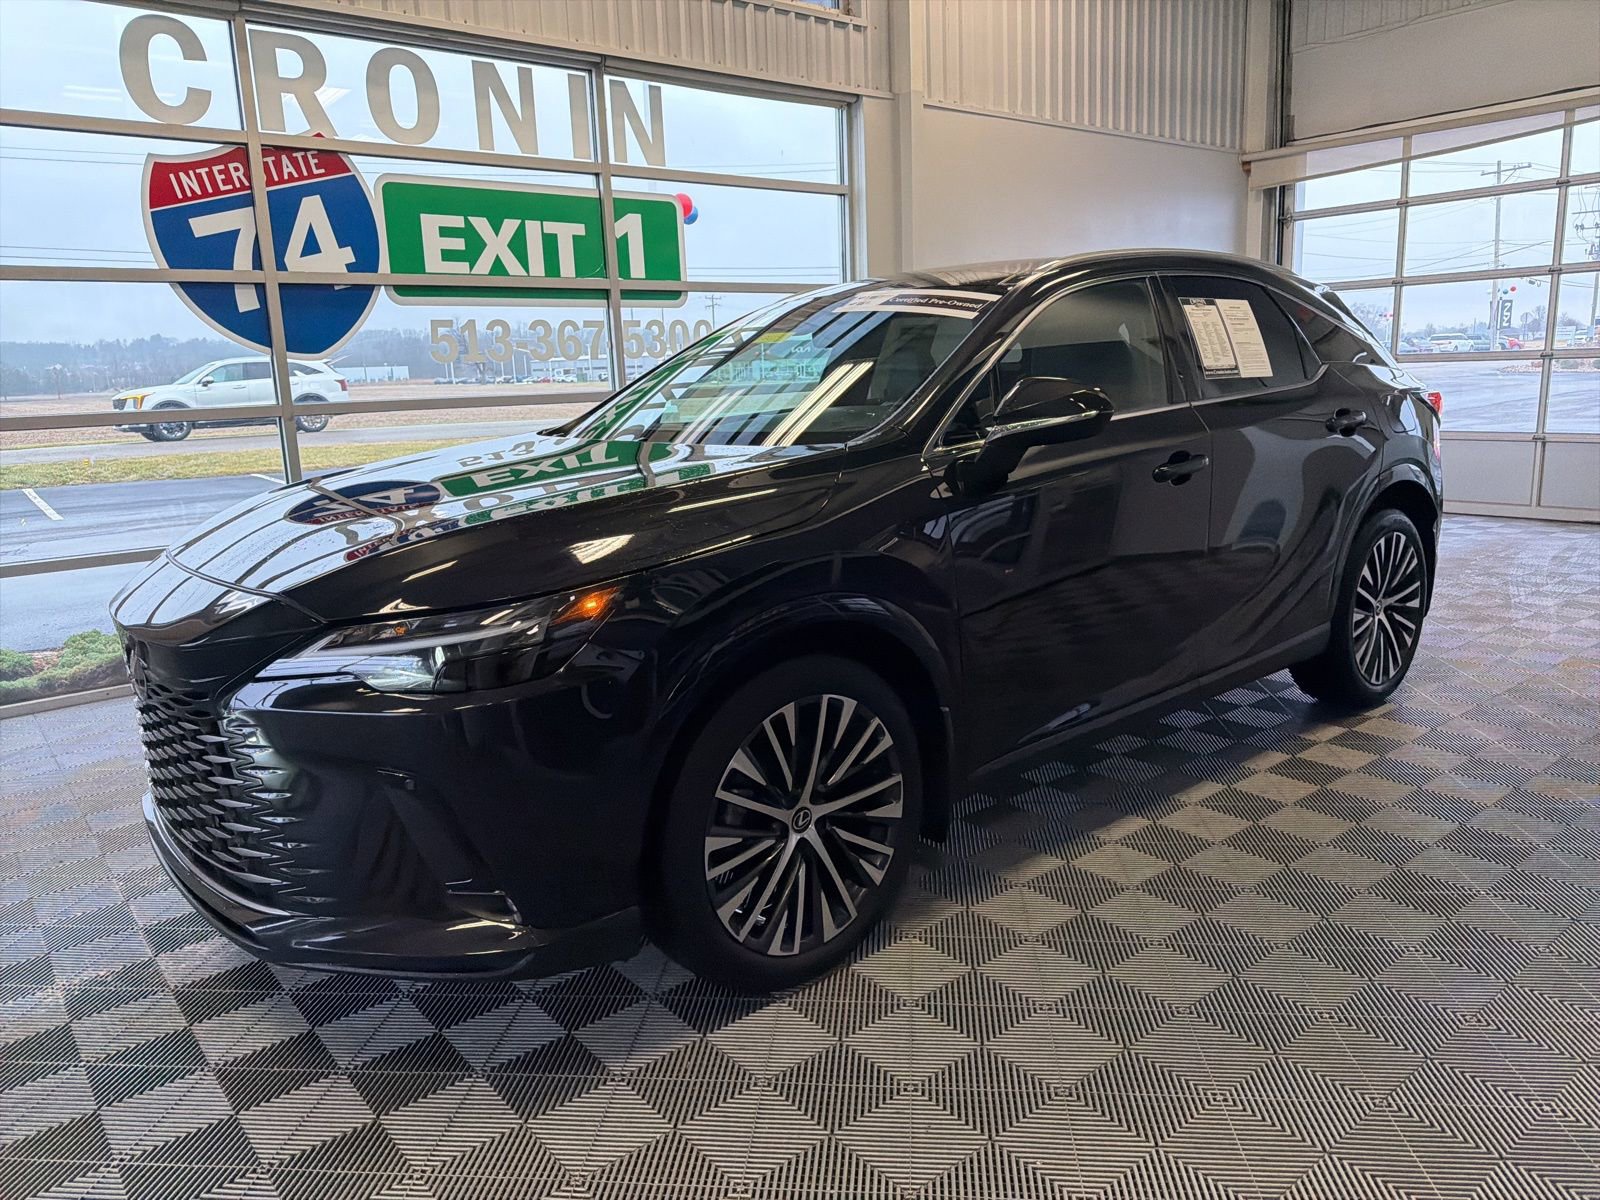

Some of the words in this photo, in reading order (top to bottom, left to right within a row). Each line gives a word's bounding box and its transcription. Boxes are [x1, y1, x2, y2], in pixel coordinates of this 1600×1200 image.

[118, 13, 666, 167] CRONIN
[168, 150, 325, 200] INTERTATE
[187, 194, 357, 313] 74
[419, 213, 586, 278] EXIT
[614, 212, 646, 279] 1
[928, 298, 984, 309] Pre-Owned
[429, 318, 713, 364] 513-367530
